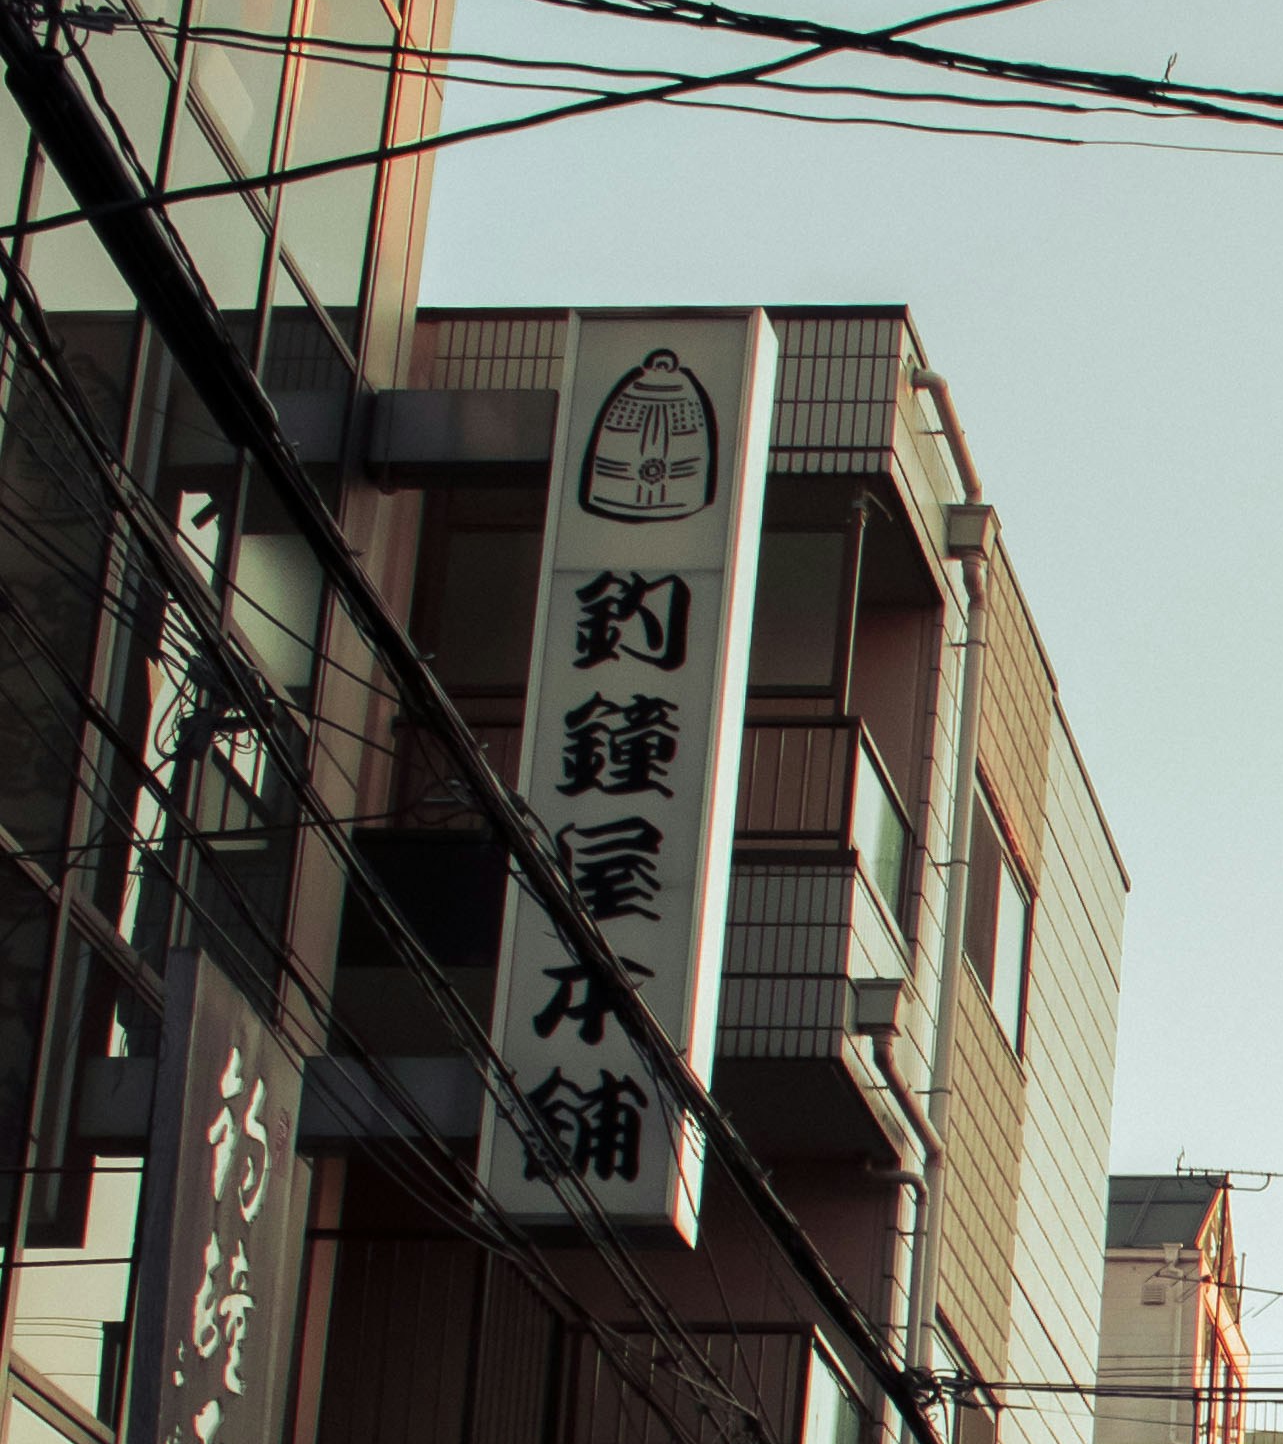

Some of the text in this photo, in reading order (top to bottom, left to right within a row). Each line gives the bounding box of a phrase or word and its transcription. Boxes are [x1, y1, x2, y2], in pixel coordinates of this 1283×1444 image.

[523, 570, 692, 1184] 釣鐘屋本舗
